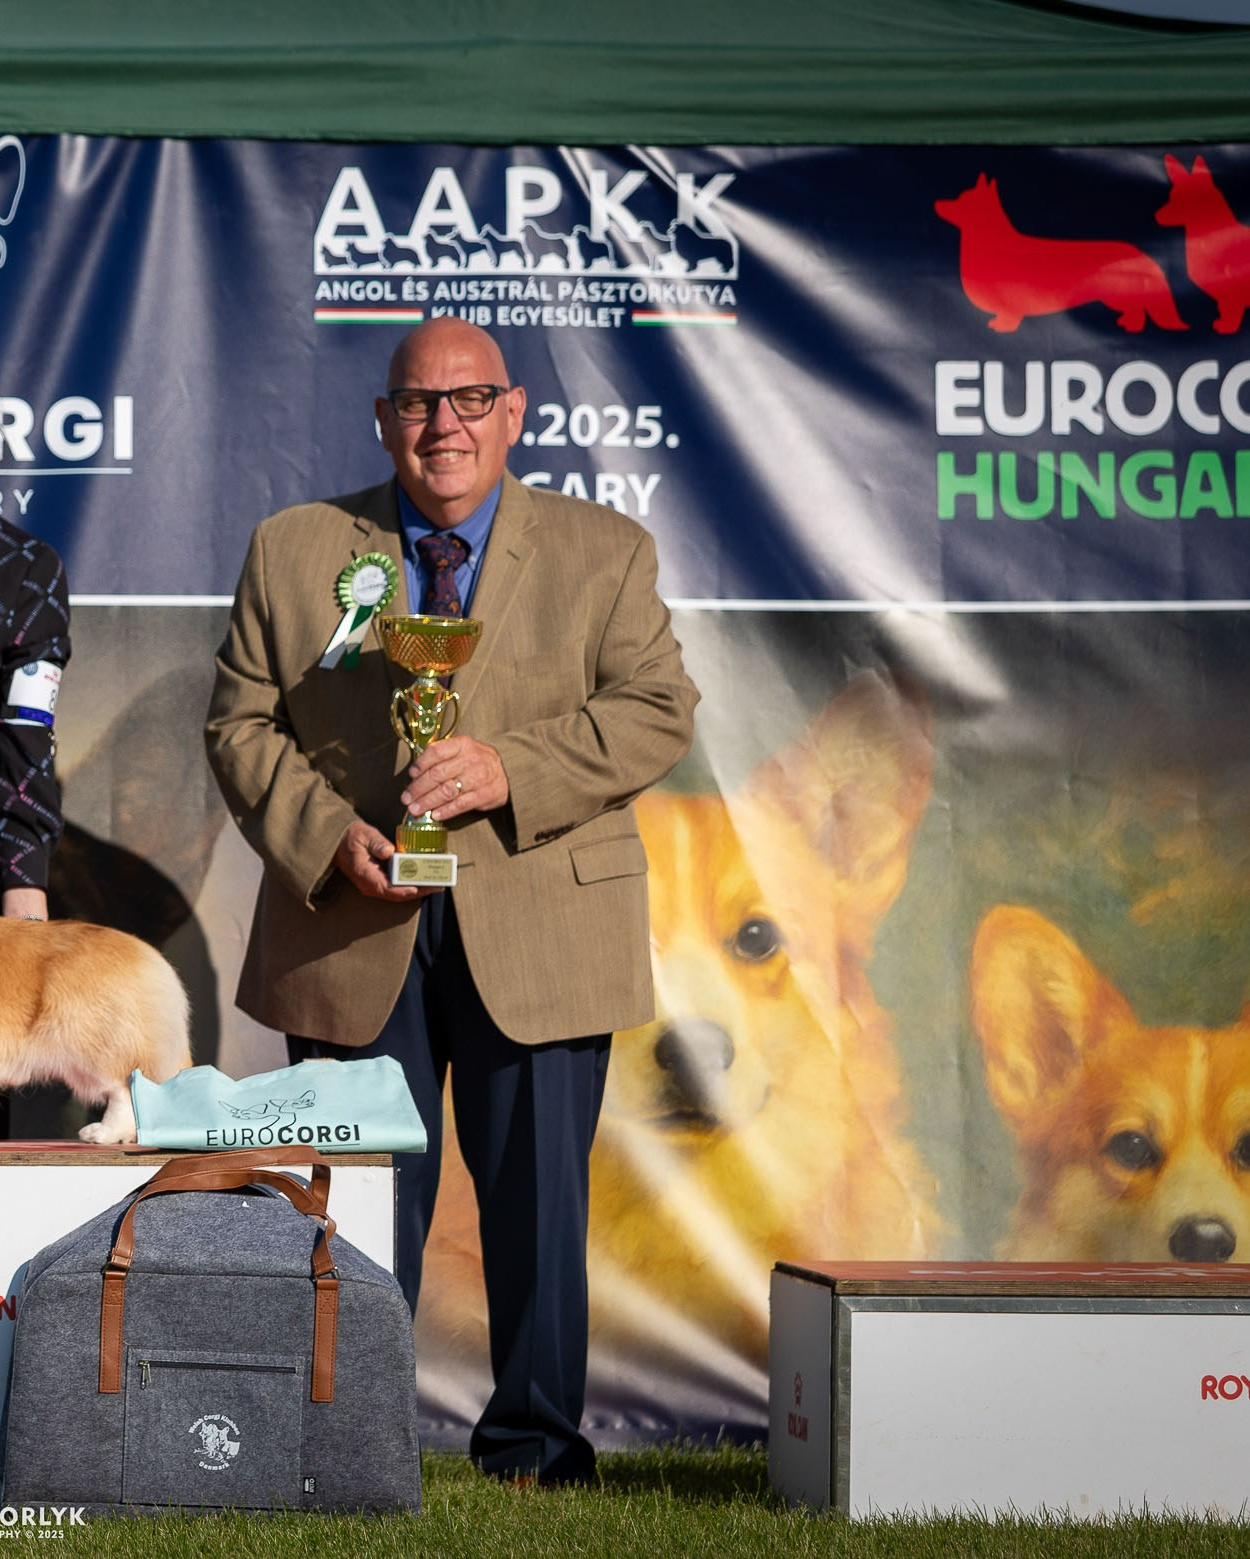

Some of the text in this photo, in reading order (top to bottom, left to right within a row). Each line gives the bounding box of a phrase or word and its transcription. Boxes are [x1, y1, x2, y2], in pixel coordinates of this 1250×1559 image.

[315, 166, 736, 241] AAPKK
[315, 276, 737, 307] ANGOL ÉS AUSZTRÁL PÁSZTORKUTYA
[497, 303, 626, 328] EGYESÜLET
[937, 450, 1250, 520] HUNGA
[206, 1124, 361, 1147] EUROCORGI
